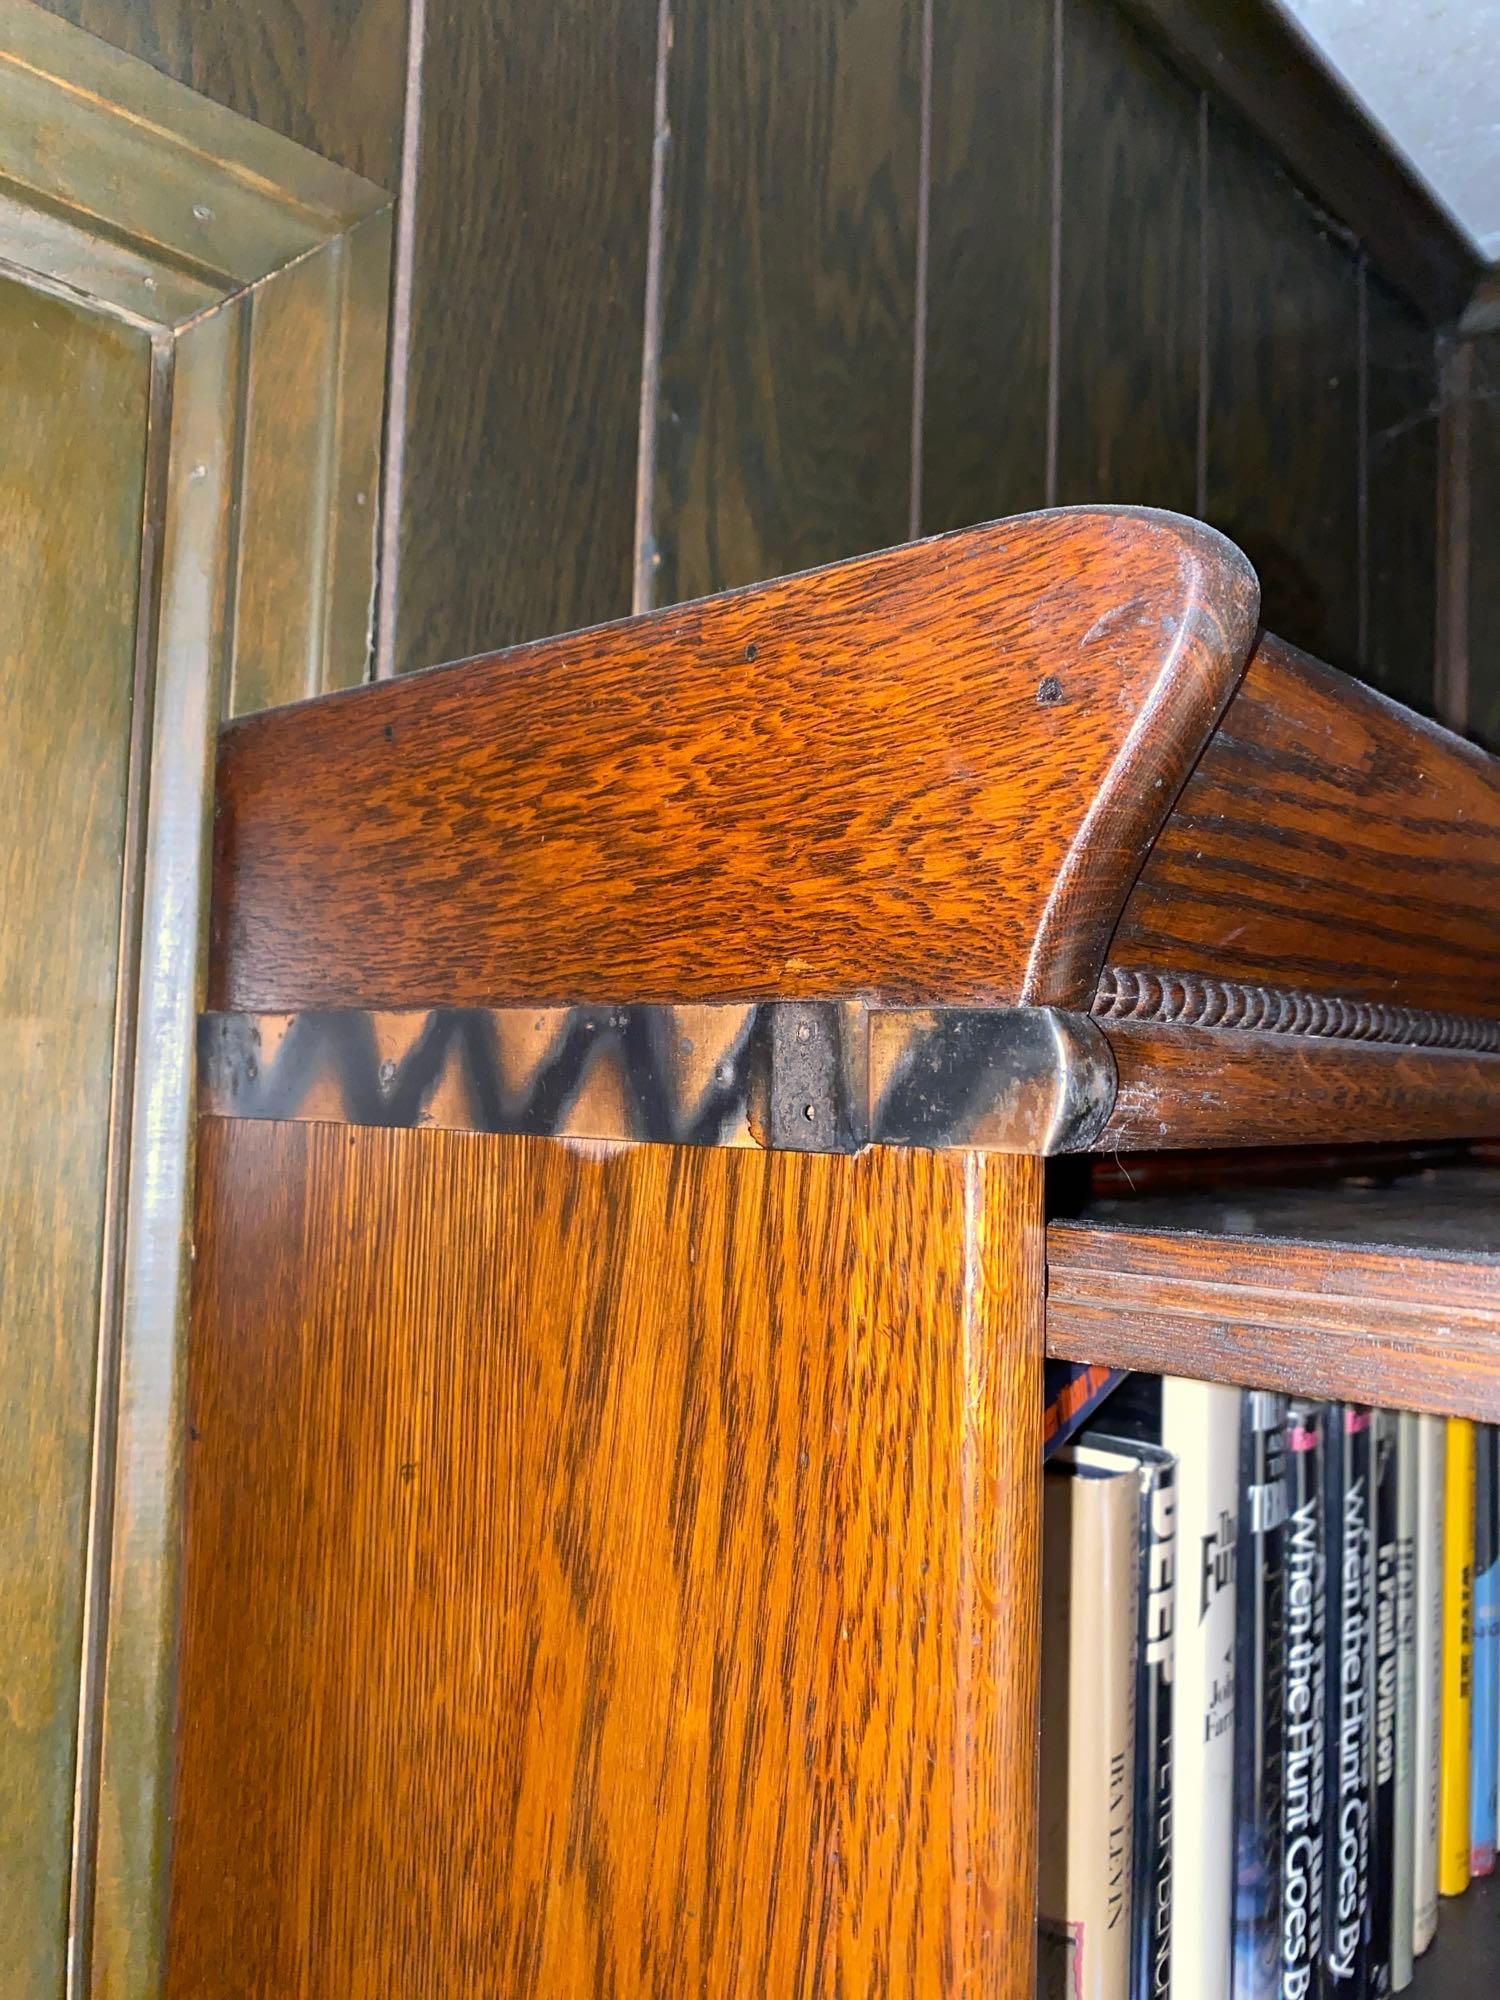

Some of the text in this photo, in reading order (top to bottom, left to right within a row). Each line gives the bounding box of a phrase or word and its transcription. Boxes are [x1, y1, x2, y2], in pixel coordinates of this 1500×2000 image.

[1145, 1487, 1174, 1685] DEEP
[1289, 1496, 1317, 1634] When
[1288, 1640, 1315, 1715] the
[1330, 1475, 1365, 1977] When the Hunt Goes By
[1377, 1657, 1396, 1785] Wilson
[1108, 1751, 1125, 1930] IRA LEVIN
[1286, 1719, 1314, 1833] Hunt
[1284, 1835, 1313, 1962] Goes
